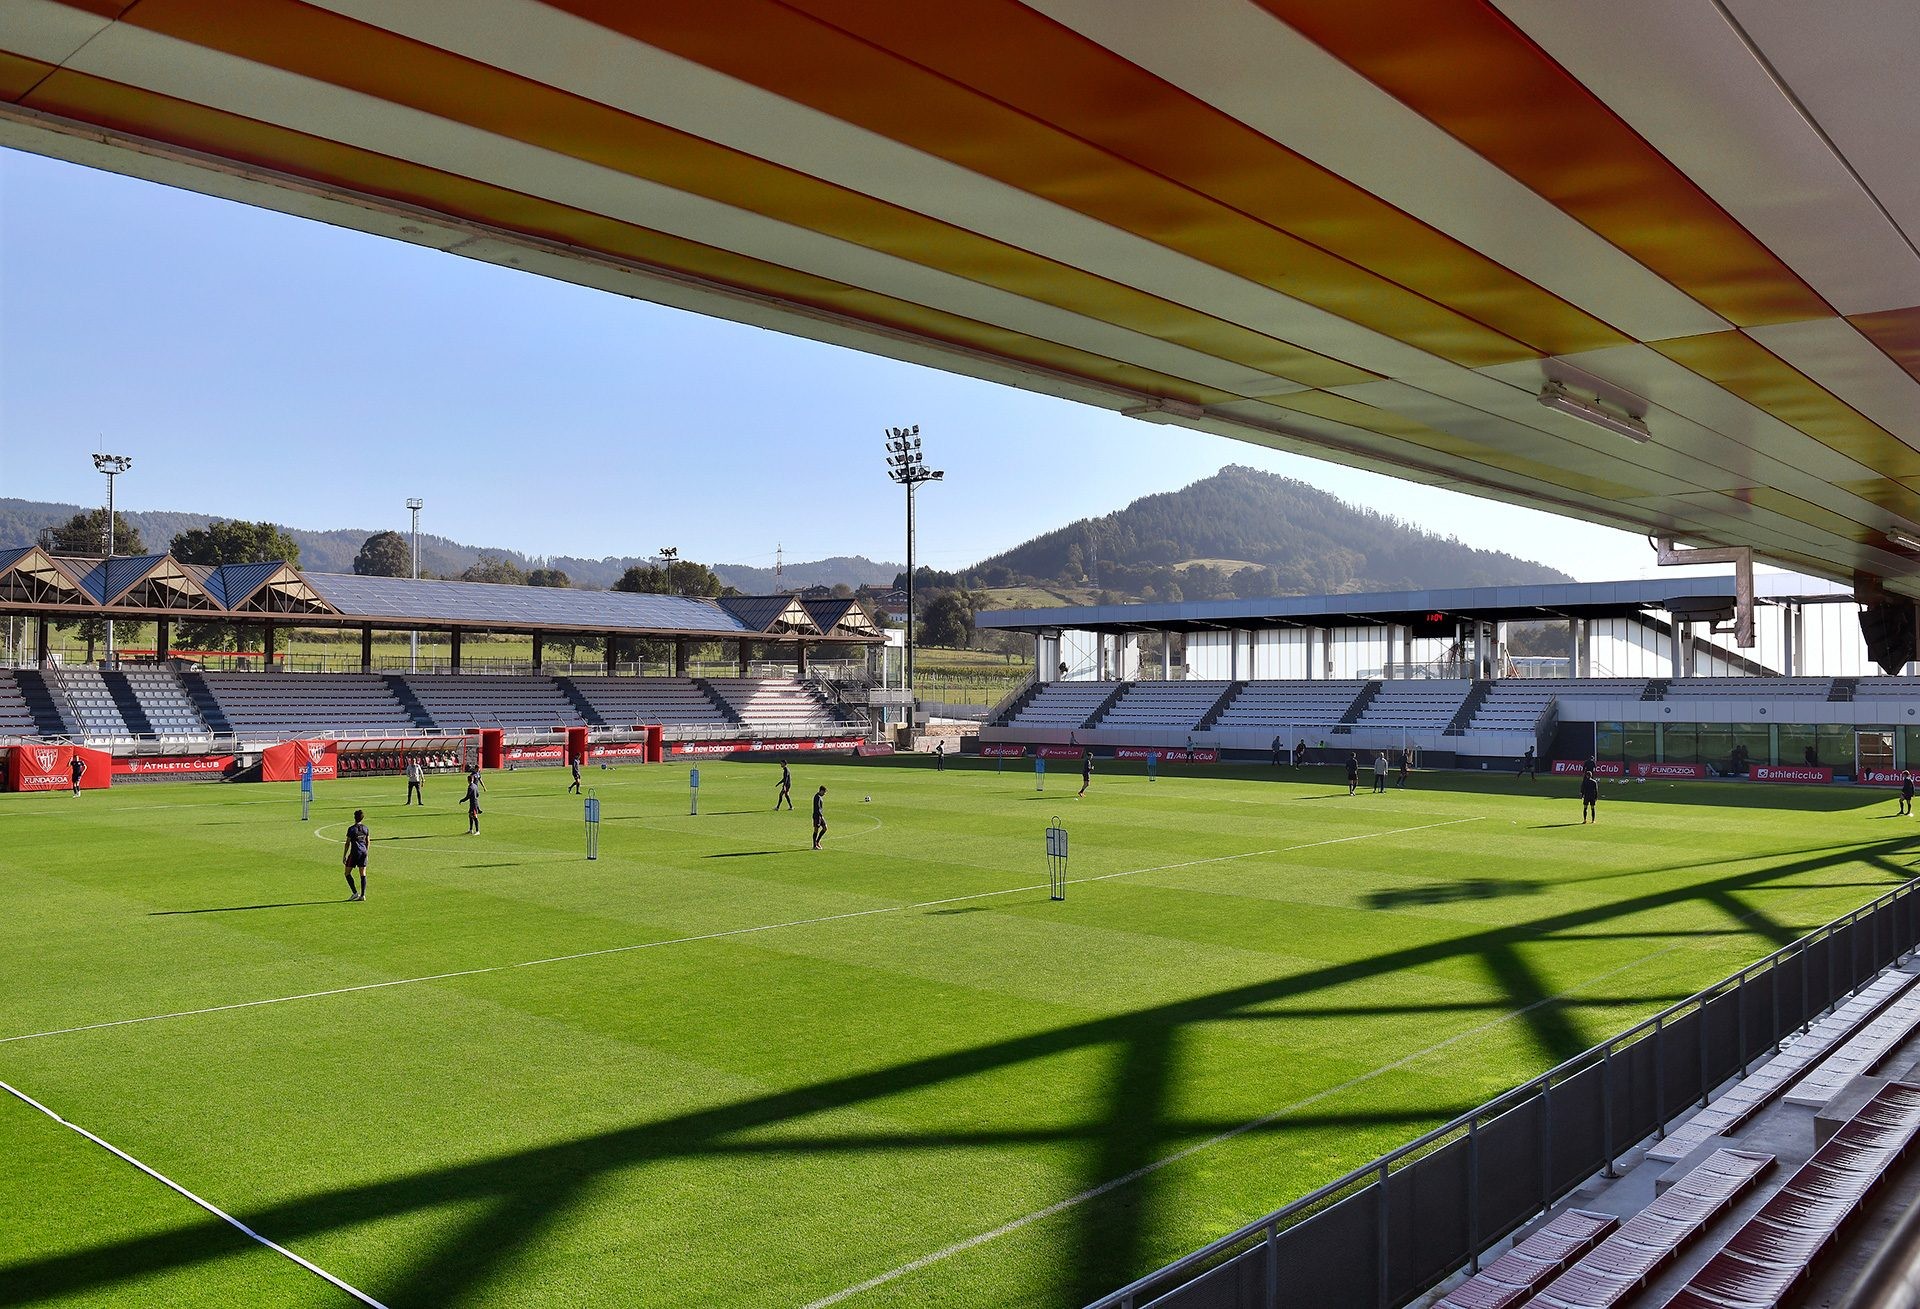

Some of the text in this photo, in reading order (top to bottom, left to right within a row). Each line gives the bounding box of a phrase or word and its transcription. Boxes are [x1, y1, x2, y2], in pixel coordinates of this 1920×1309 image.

[1173, 752, 1214, 760] /AthticClub
[1565, 763, 1619, 772] /AthicClub
[1769, 770, 1823, 780] athleticclub
[1875, 772, 1920, 782] @athlic
